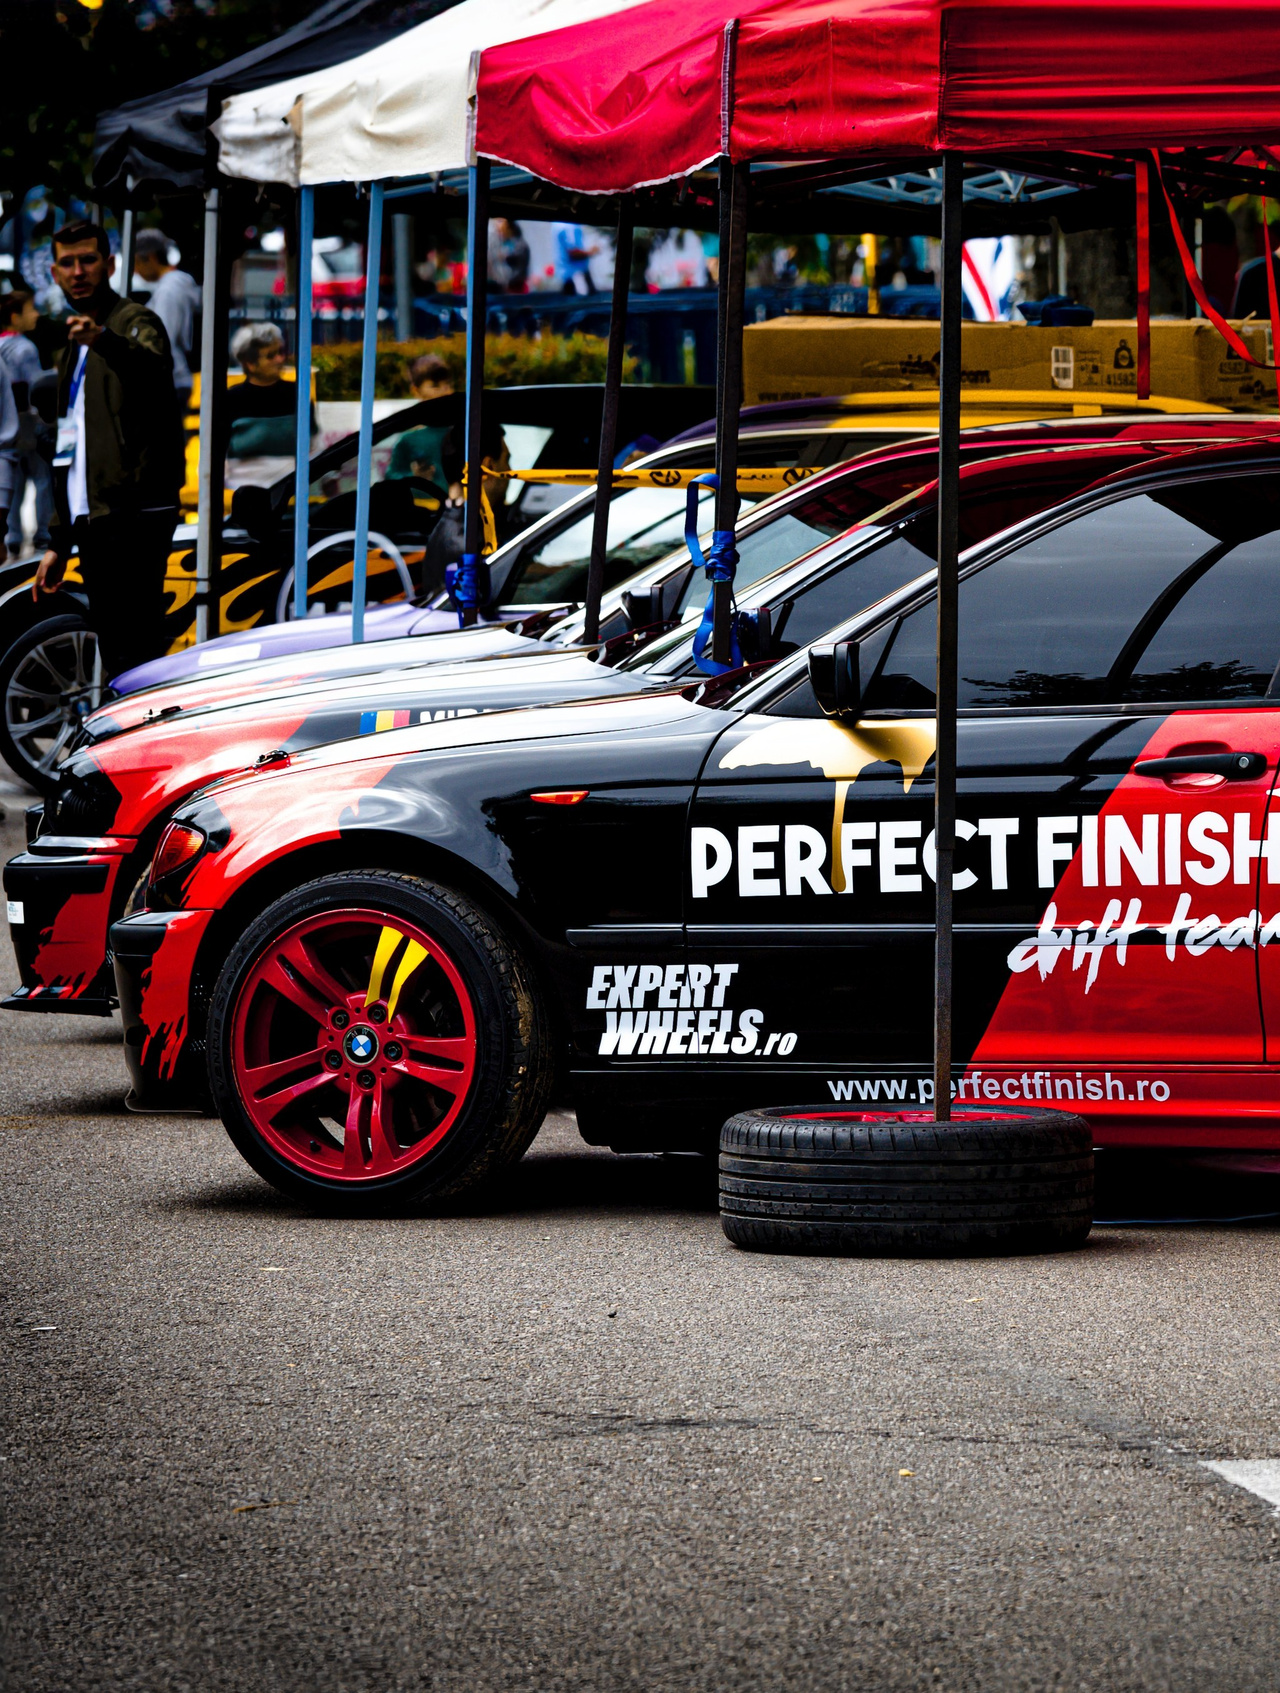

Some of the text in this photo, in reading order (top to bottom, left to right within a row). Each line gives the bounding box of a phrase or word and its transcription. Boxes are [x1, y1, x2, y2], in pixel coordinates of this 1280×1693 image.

[691, 817, 1020, 898] PERFECT
[1007, 898, 1149, 995] drift
[586, 963, 739, 1010] EXPERT
[598, 1010, 798, 1056] WHEELS.ro
